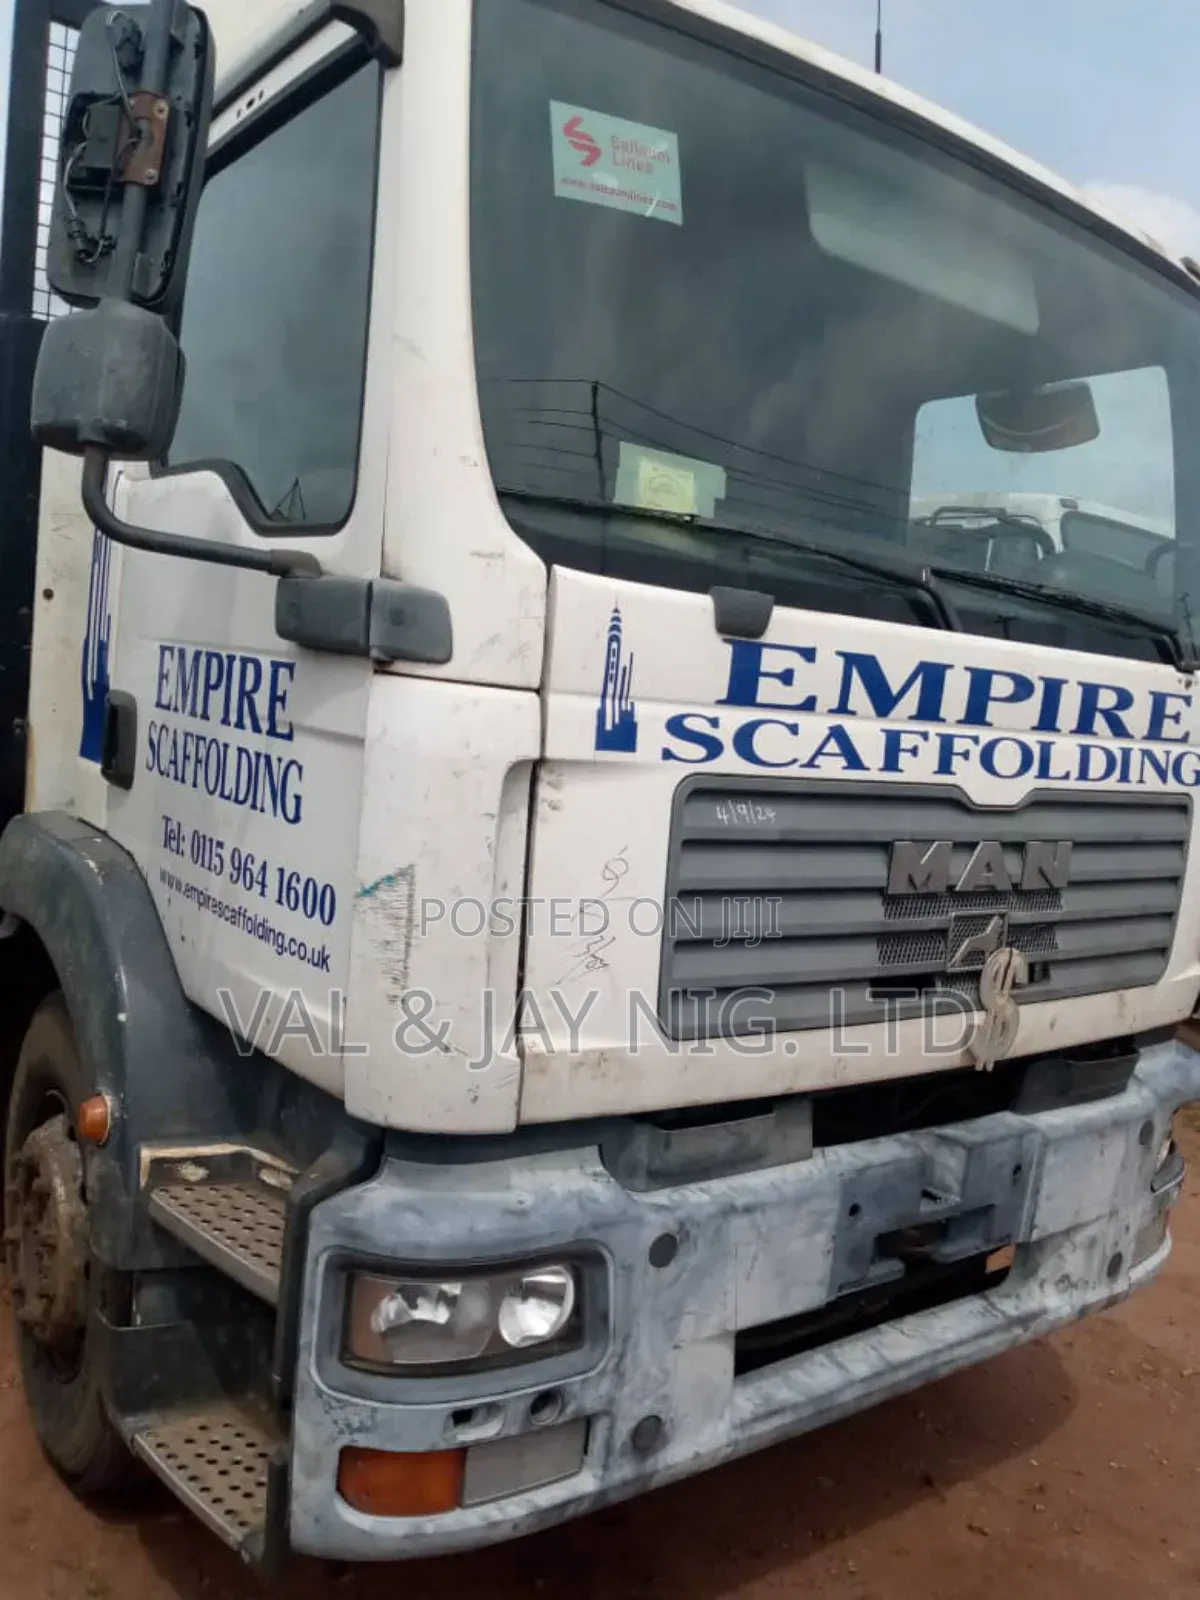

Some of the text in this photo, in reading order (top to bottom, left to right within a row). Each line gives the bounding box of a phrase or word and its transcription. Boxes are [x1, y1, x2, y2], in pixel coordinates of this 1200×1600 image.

[155, 644, 296, 742] EMPIRE
[716, 637, 1193, 743] EMPIRE
[145, 720, 303, 825] SCAFFOLDING
[661, 713, 1200, 787] SCAFFOLDING
[161, 815, 336, 925] Tel: 0115 964 1600
[887, 840, 1073, 894] MAN
[159, 867, 331, 973] www.empirescaffolding.co.uk
